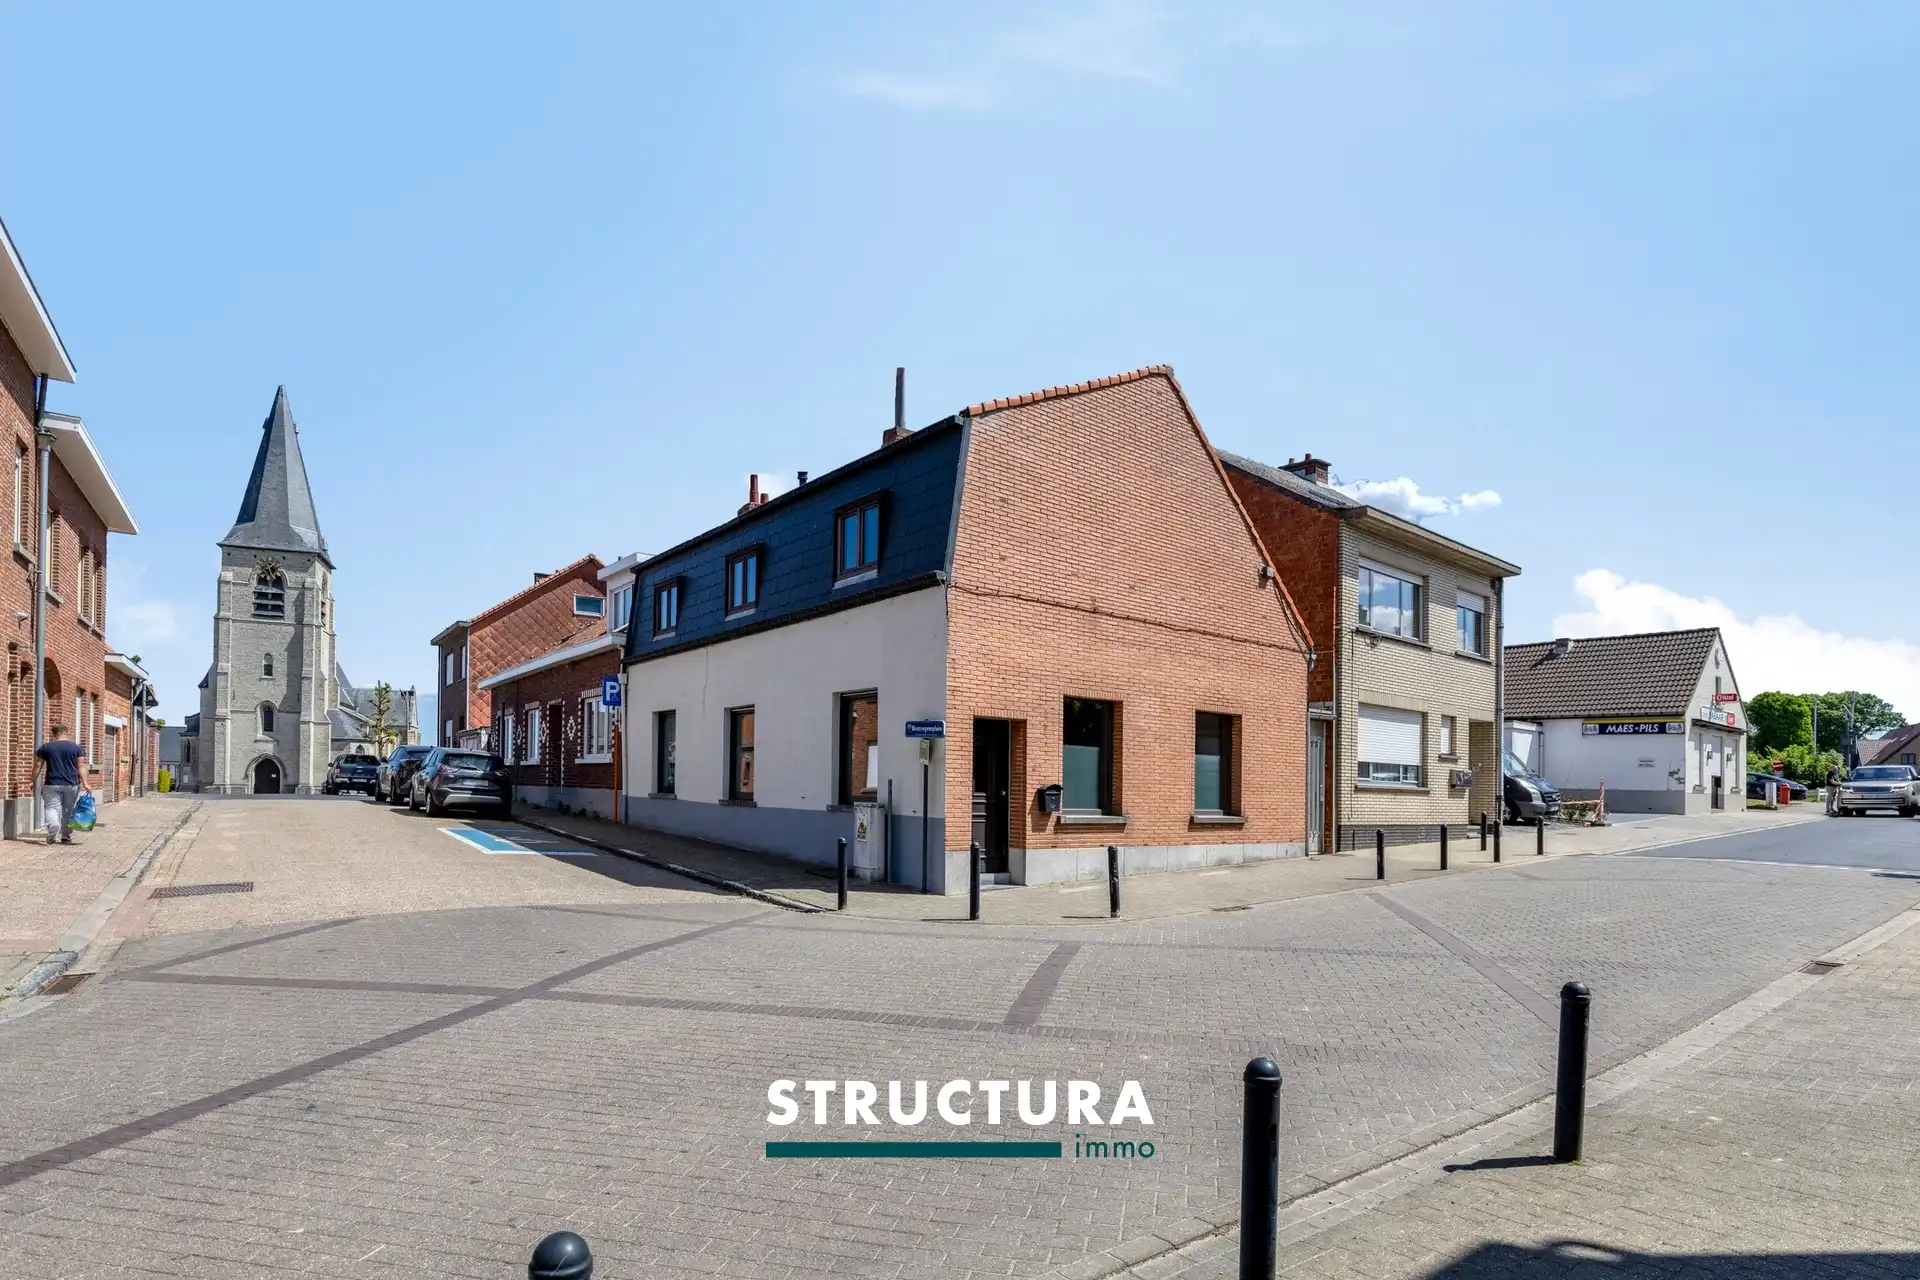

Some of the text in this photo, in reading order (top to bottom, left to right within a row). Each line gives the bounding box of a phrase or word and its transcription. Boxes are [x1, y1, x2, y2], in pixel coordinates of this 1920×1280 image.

[605, 681, 620, 702] P
[1605, 724, 1634, 733] MAES
[1639, 723, 1659, 733] PILS
